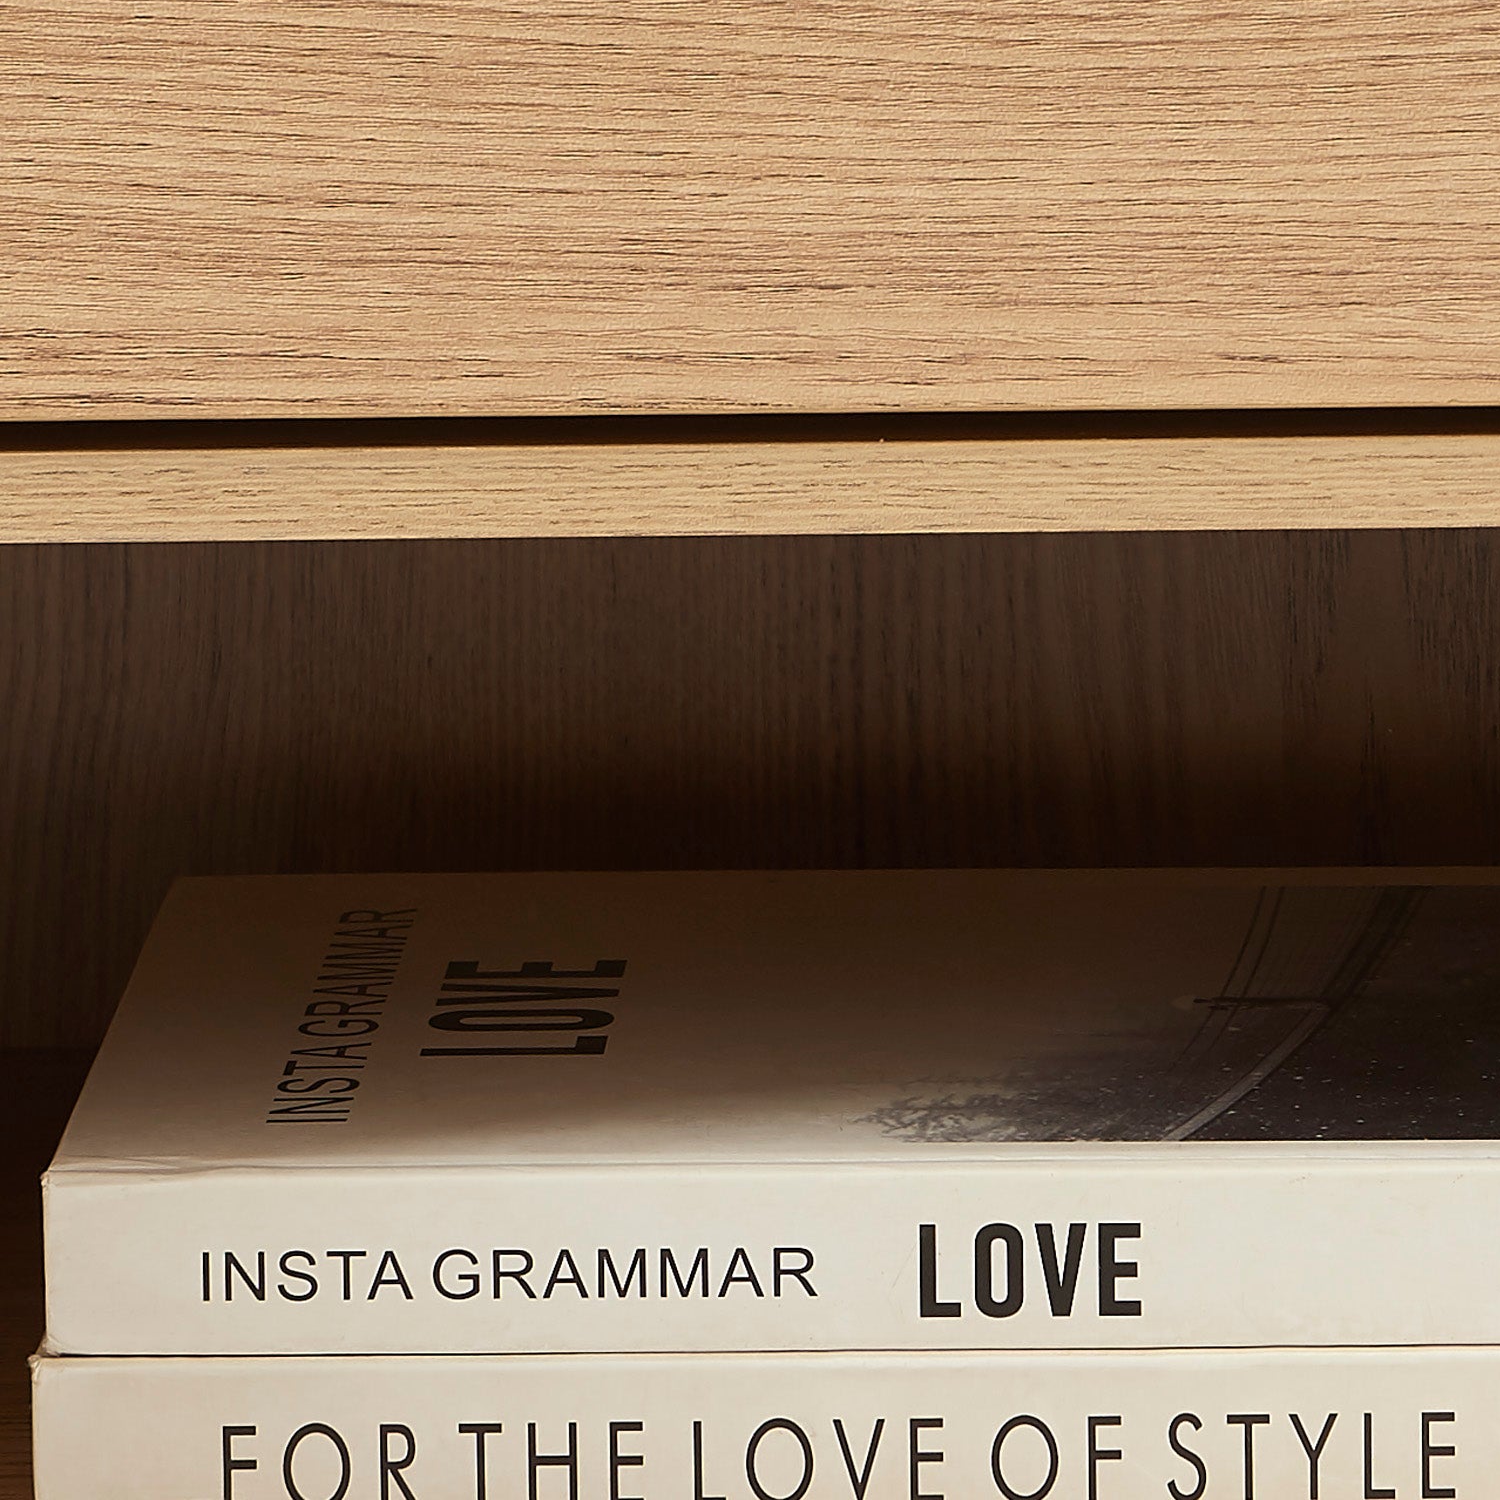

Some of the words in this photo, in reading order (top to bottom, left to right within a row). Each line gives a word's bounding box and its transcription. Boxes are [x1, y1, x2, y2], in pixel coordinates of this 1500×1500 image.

[419, 958, 629, 1057] LOVE
[202, 1250, 414, 1302] INSTA
[432, 1247, 819, 1301] GRAMMAR
[918, 1222, 1142, 1319] LOVE
[222, 1422, 416, 1500] FOR
[458, 1421, 645, 1500] THE
[692, 1417, 945, 1500] LOVE
[990, 1414, 1123, 1500] OF
[1166, 1411, 1456, 1500] STYLE
